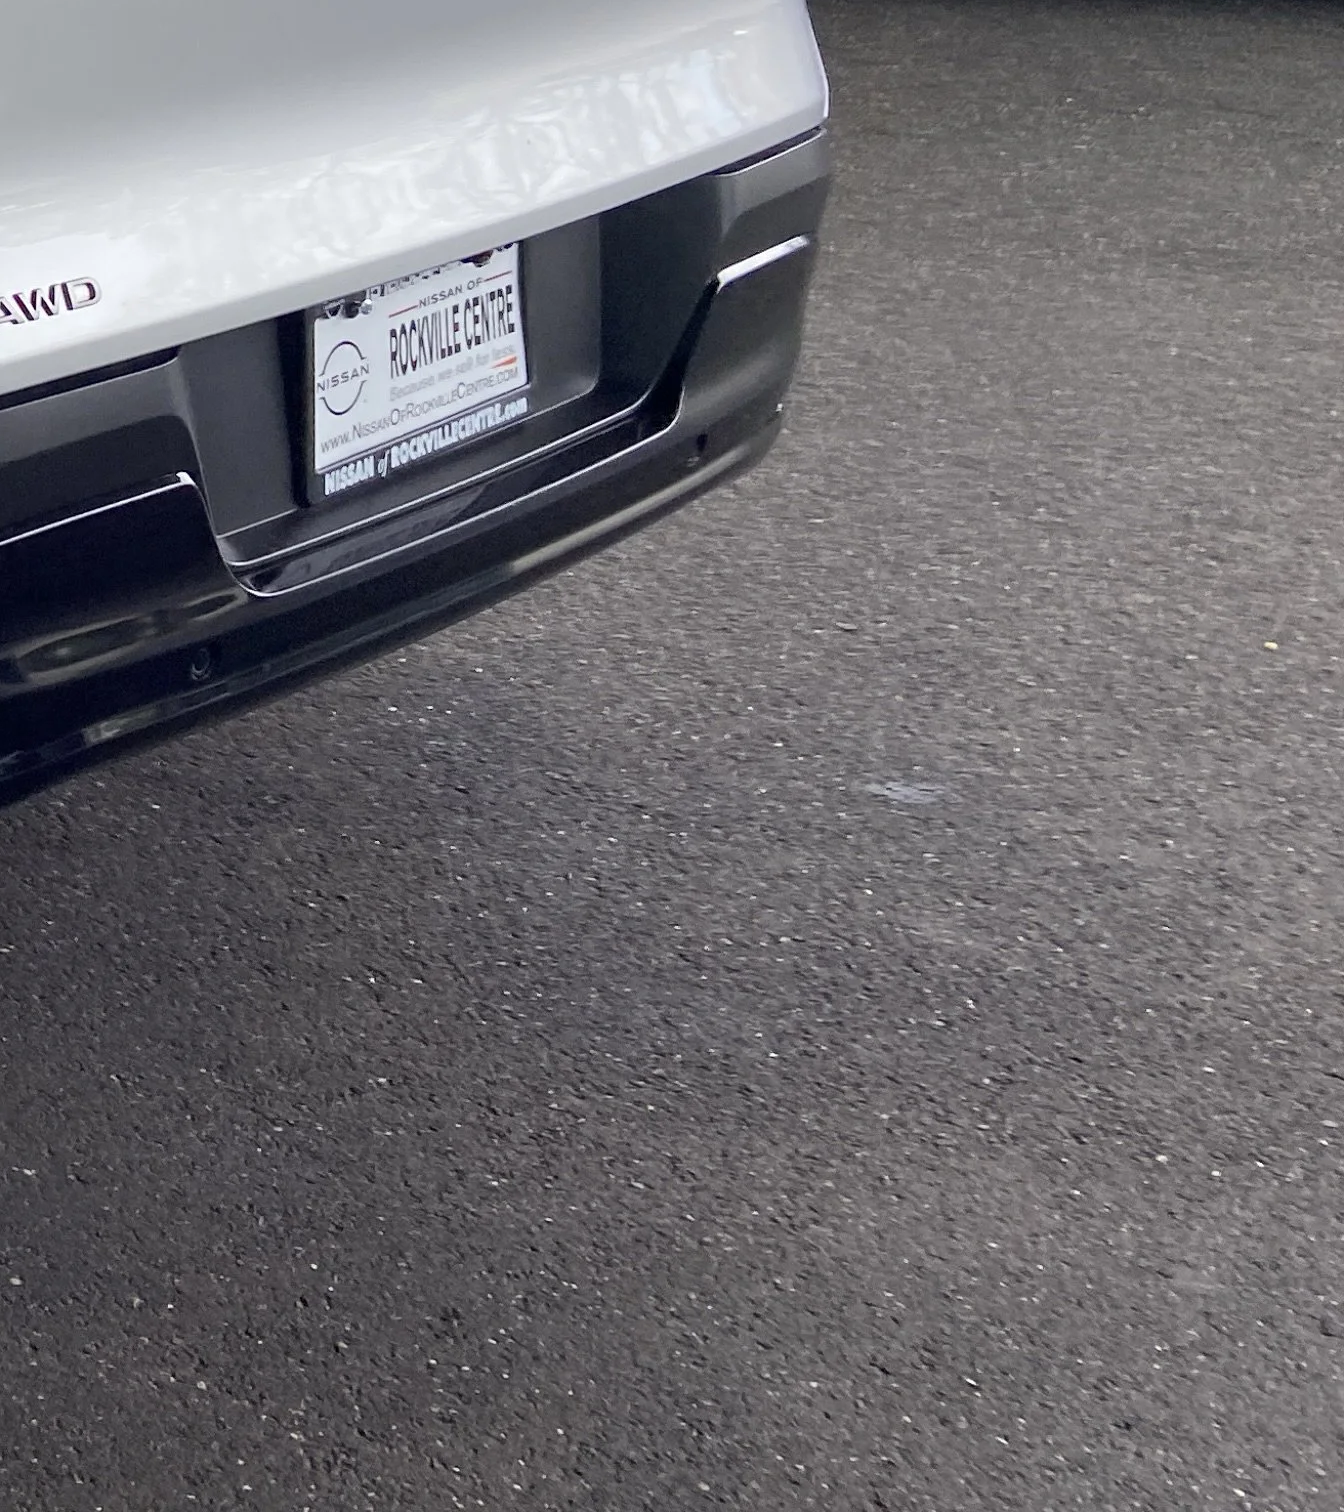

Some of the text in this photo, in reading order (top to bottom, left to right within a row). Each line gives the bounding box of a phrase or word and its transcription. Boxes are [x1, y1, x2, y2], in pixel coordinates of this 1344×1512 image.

[418, 277, 483, 308] NISSAN OF
[389, 284, 515, 379] ROCKVILLE CENTRE
[316, 364, 370, 393] NISSAN
[324, 455, 375, 496] NISSAN
[377, 449, 389, 478] of
